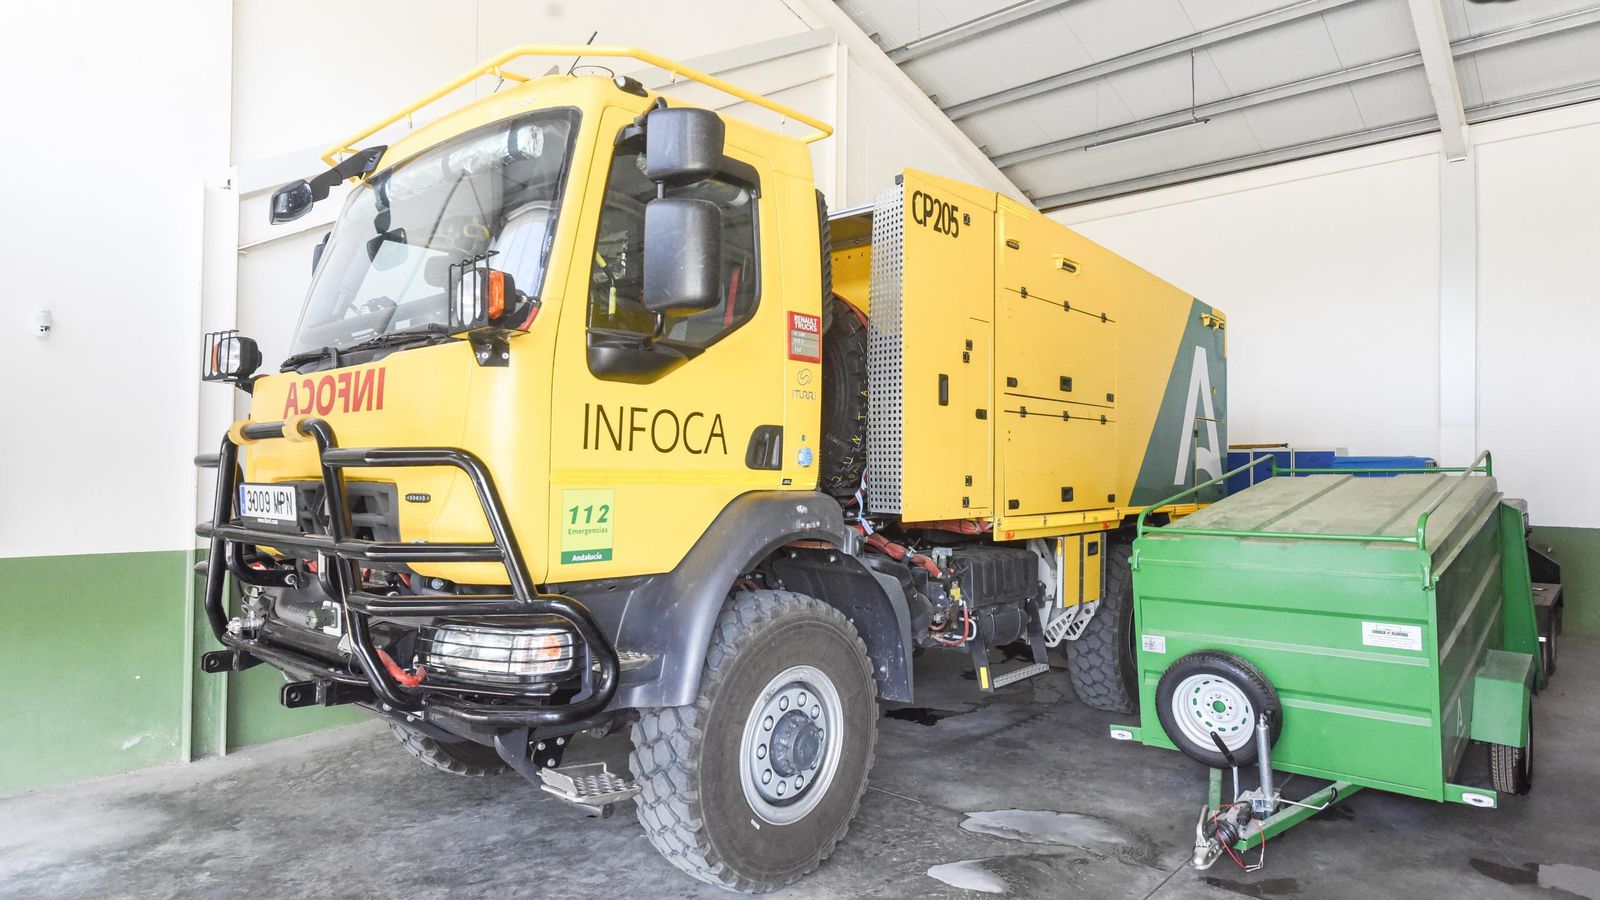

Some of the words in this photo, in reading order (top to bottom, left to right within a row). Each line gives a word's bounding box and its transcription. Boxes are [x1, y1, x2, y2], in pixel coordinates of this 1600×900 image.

[911, 190, 960, 239] CP205
[793, 314, 818, 327] RENAULT
[794, 321, 818, 333] TRUCKS
[583, 402, 728, 455] INFOCA
[247, 490, 271, 513] 3009
[273, 491, 293, 515] MPN
[568, 504, 610, 525] 112
[567, 527, 608, 536] Emergencias
[571, 552, 603, 562] Andalucía
